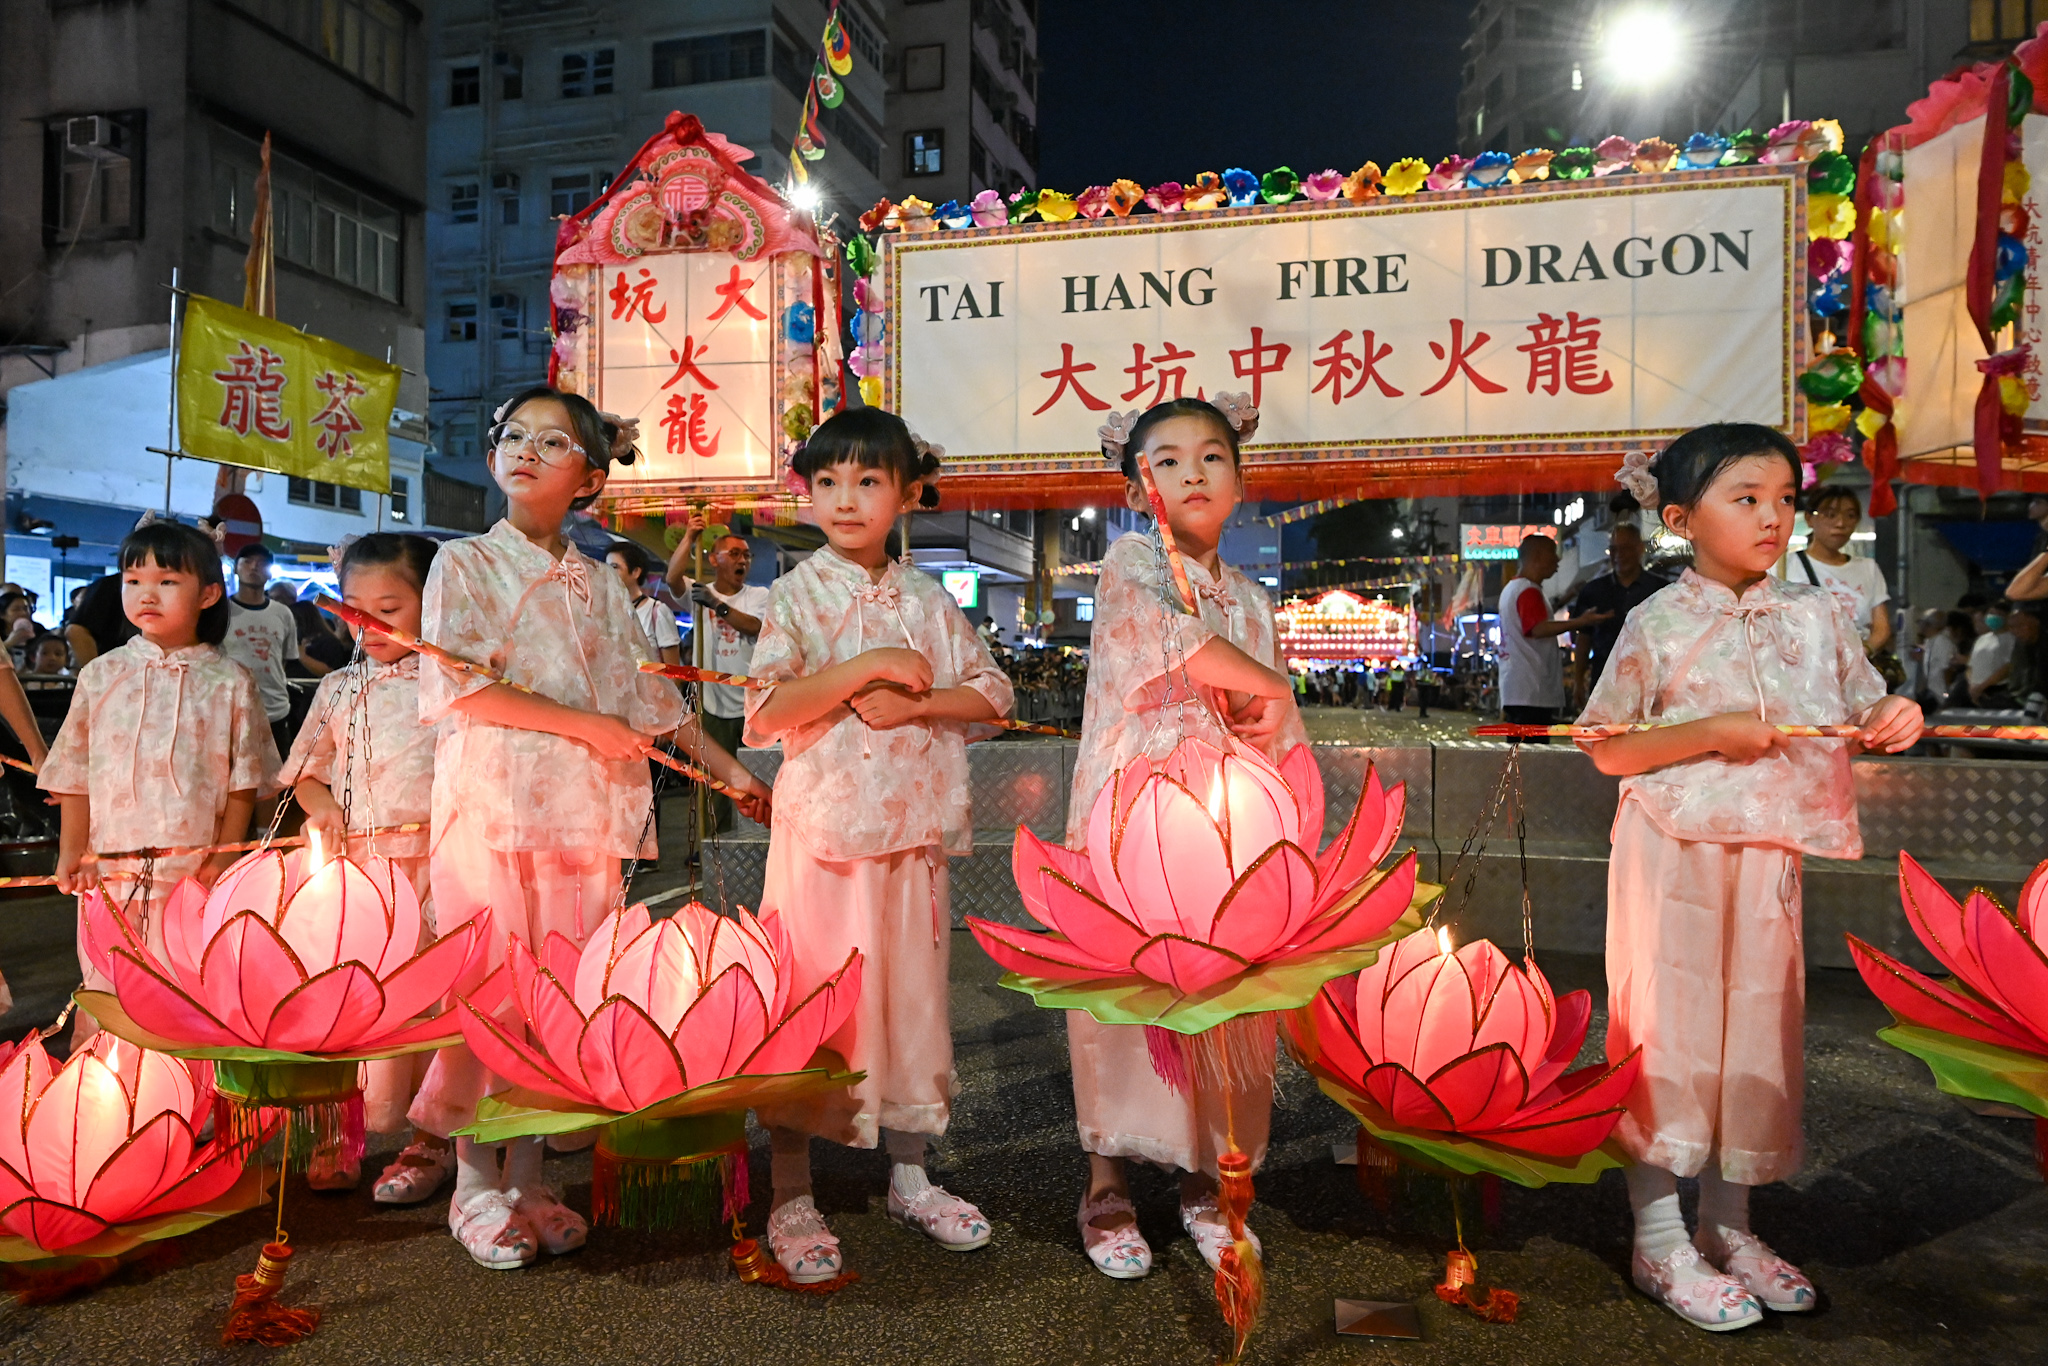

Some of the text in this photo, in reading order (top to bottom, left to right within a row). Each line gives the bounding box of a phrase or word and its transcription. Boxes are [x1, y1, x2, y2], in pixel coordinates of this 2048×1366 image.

[920, 229, 1753, 322] TAI HANG FIRE DRAGON
[1032, 311, 1615, 416] 大坑中秋火龍
[1464, 546, 1519, 560] Locom
